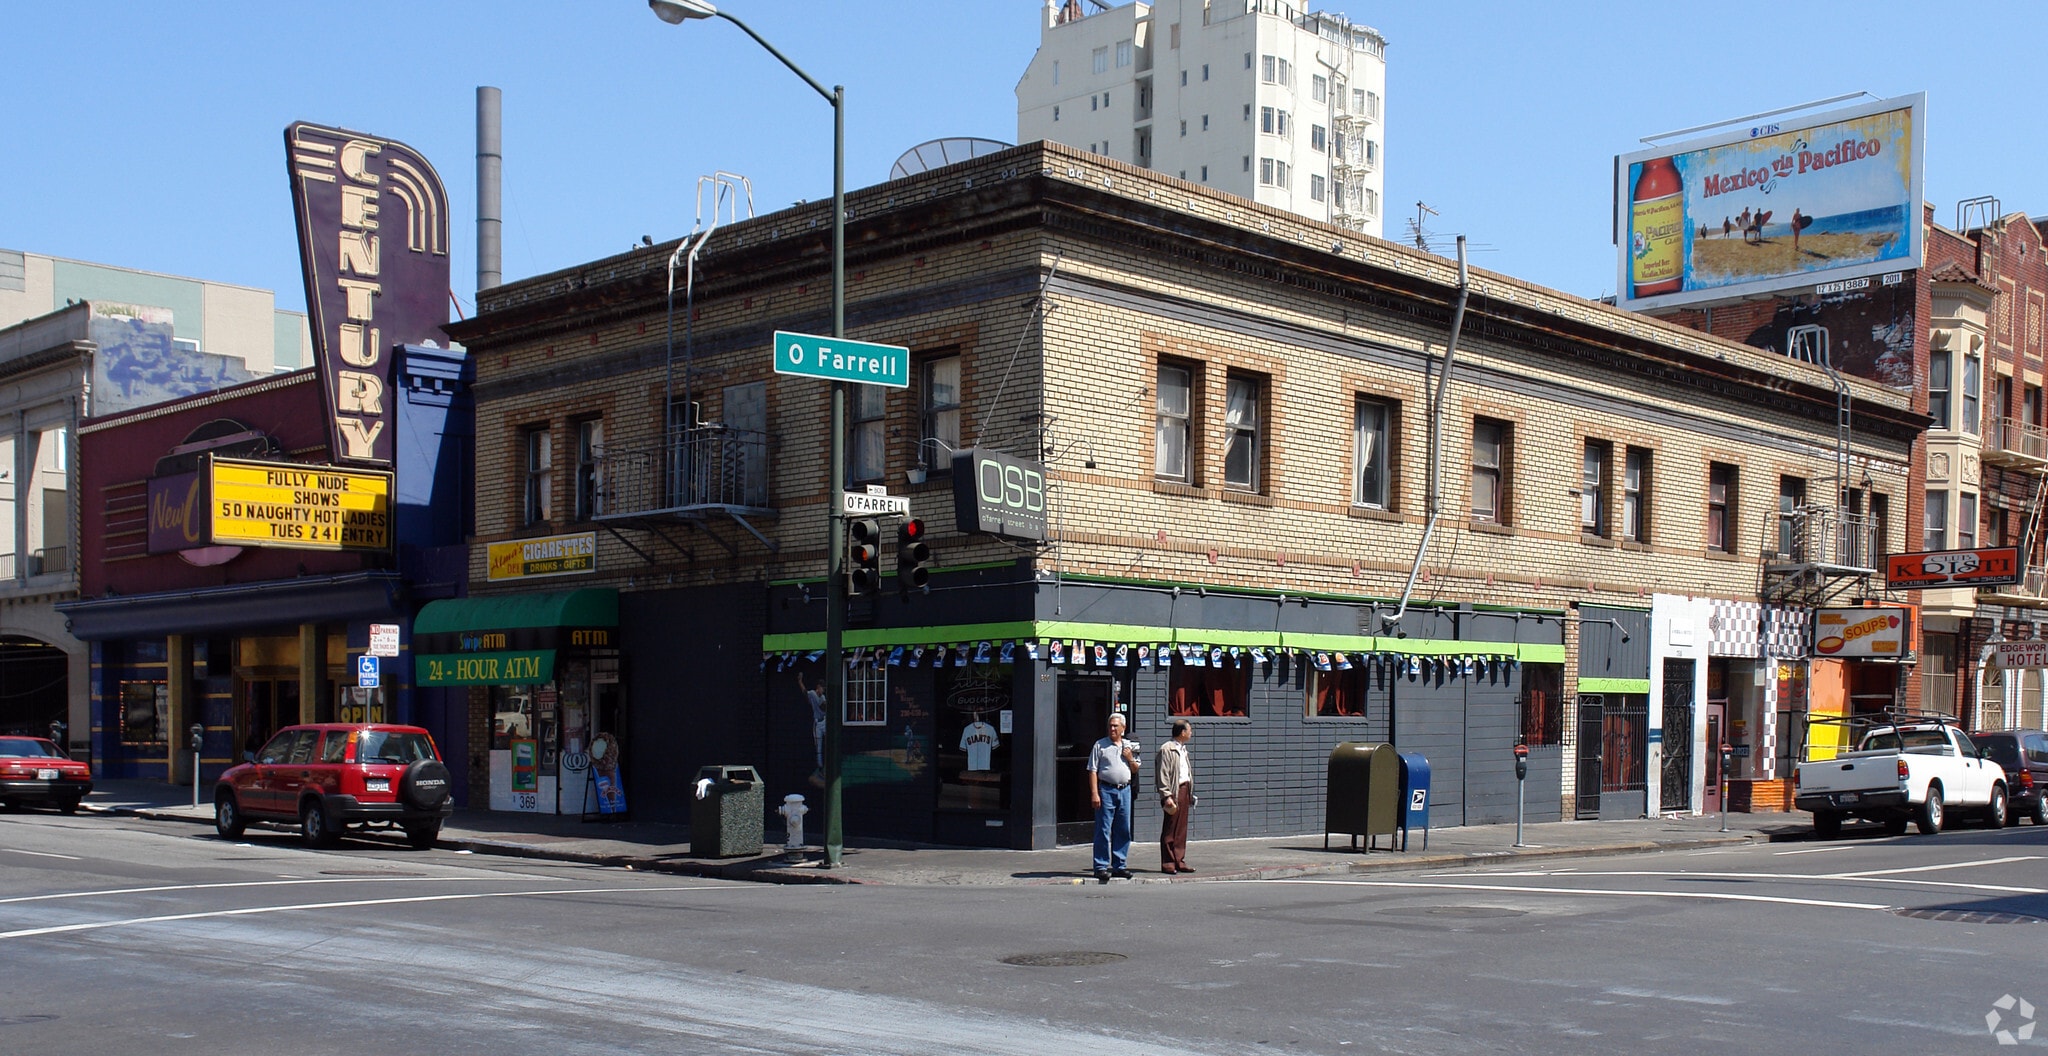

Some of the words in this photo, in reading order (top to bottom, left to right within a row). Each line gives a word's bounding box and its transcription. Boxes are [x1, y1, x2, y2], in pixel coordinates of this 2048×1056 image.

[1760, 124, 1780, 136] CBS
[1703, 167, 1770, 198] Mexico
[1771, 154, 1794, 171] via
[1798, 138, 1881, 174] Pacifico
[1846, 279, 1869, 289] 3887
[1885, 273, 1900, 284] 2011
[338, 138, 384, 458] CENTURY
[788, 343, 804, 365] O
[818, 347, 896, 376] Farrell
[267, 471, 309, 488] FULLY
[318, 476, 349, 491] NUDE
[980, 459, 1044, 512] OSB
[294, 491, 340, 507] SHOWS
[847, 496, 903, 512] O'FARRELL
[151, 488, 184, 535] New
[247, 505, 311, 522] NAUGHTY
[315, 508, 339, 524] HOT
[342, 511, 386, 527] LADIES
[270, 523, 303, 539] TUES
[341, 527, 384, 544] ENTRY
[523, 536, 593, 561] CIGARETTES
[1931, 553, 1973, 562] CLUB
[529, 561, 558, 573] DRINKS
[564, 558, 587, 569] GIFTS
[1844, 617, 1887, 639] SOUPS
[572, 630, 608, 645] ATM
[429, 660, 443, 681] 24
[456, 659, 499, 681] HOUR
[503, 656, 540, 680] ATM
[2007, 653, 2048, 666] HOTEL
[966, 734, 991, 746] GIANTS
[519, 795, 536, 809] 369
